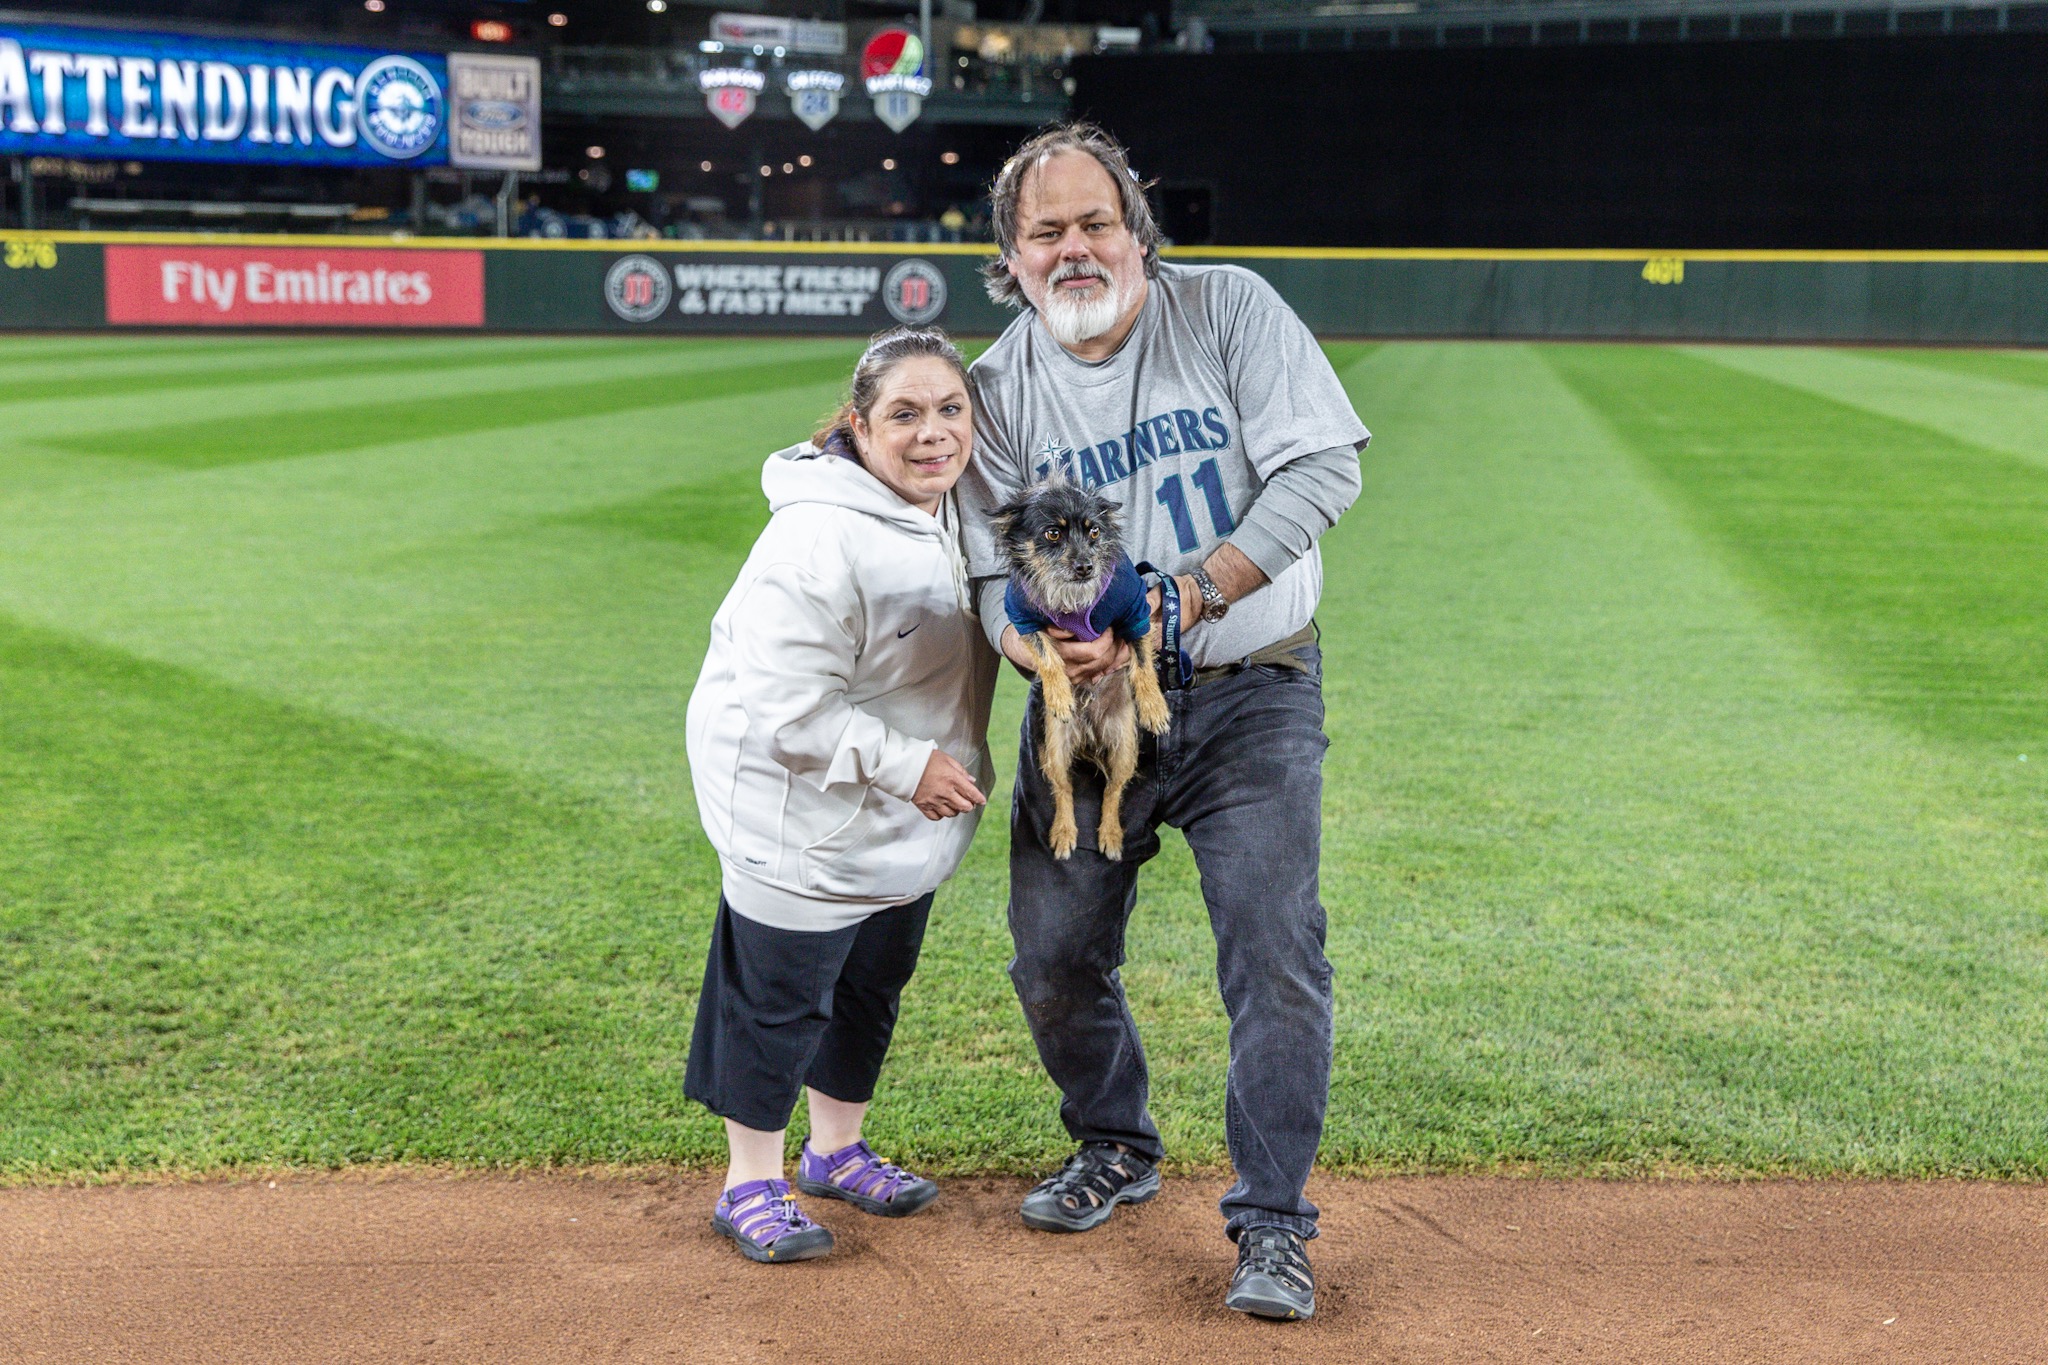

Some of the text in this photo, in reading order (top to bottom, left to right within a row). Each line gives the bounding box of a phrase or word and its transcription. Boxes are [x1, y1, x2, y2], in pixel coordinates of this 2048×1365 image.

[0, 37, 357, 147] ATTENDING
[161, 260, 432, 312] Fly Emirates
[674, 264, 881, 292] WHERE FRESH
[678, 291, 871, 316] & FAST MEET
[1155, 457, 1235, 554] 11
[1165, 614, 1178, 653] MARINERS
